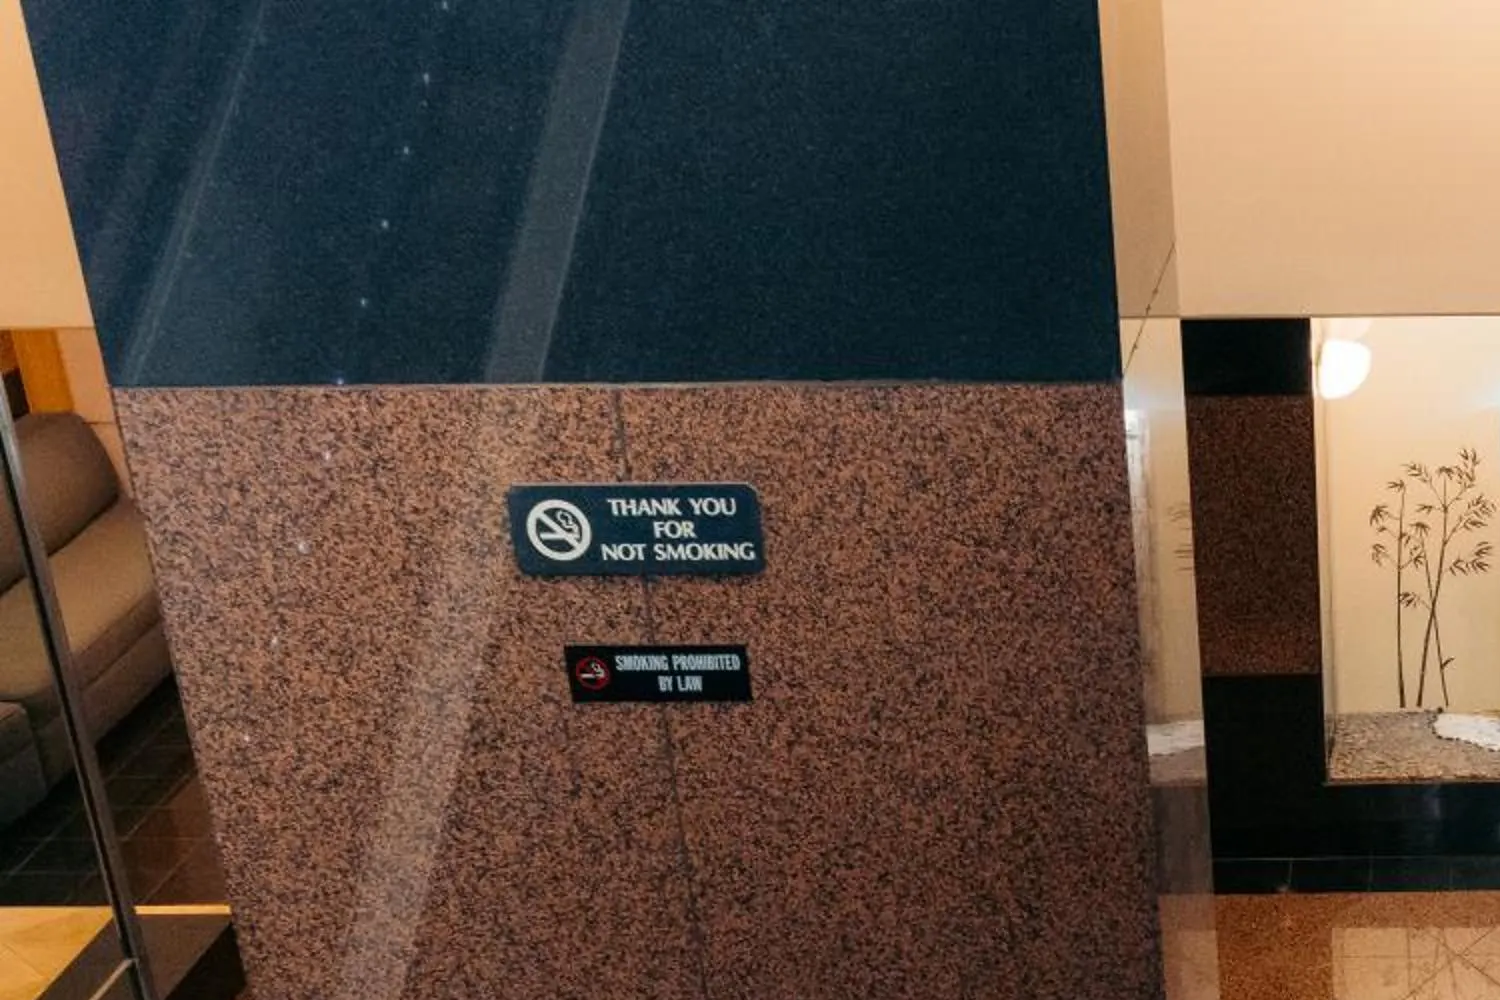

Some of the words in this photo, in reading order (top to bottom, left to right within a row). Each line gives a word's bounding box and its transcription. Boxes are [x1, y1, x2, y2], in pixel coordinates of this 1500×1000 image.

[608, 498, 680, 516] THANK
[689, 498, 737, 516] YOU
[653, 521, 698, 539] FOR
[601, 543, 647, 561] NOT
[653, 543, 756, 561] SMOKING
[614, 654, 669, 671] SMOKING
[671, 653, 741, 671] PROHIBITED
[657, 675, 673, 692] BY
[676, 675, 703, 692] LAW
